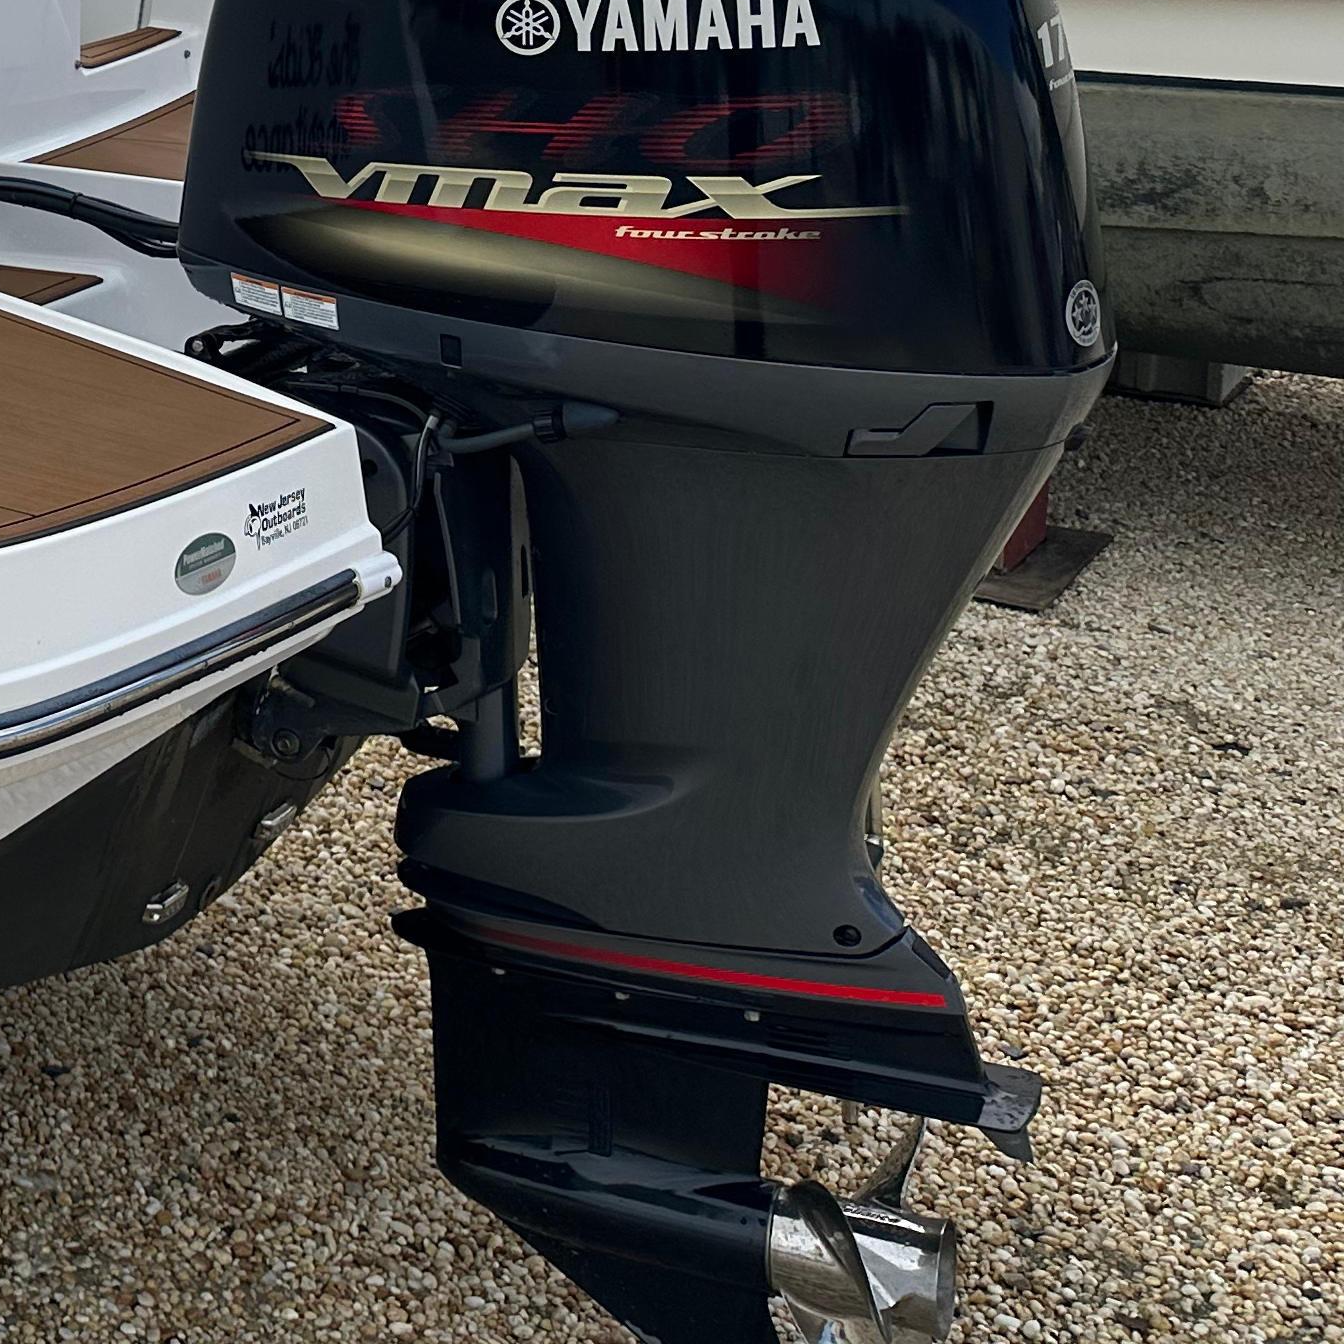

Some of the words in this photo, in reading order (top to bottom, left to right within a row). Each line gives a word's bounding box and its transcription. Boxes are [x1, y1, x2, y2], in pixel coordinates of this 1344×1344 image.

[1037, 14, 1066, 68] 17
[257, 501, 277, 517] New
[278, 487, 306, 509] Jersey
[262, 501, 307, 532] Outboards
